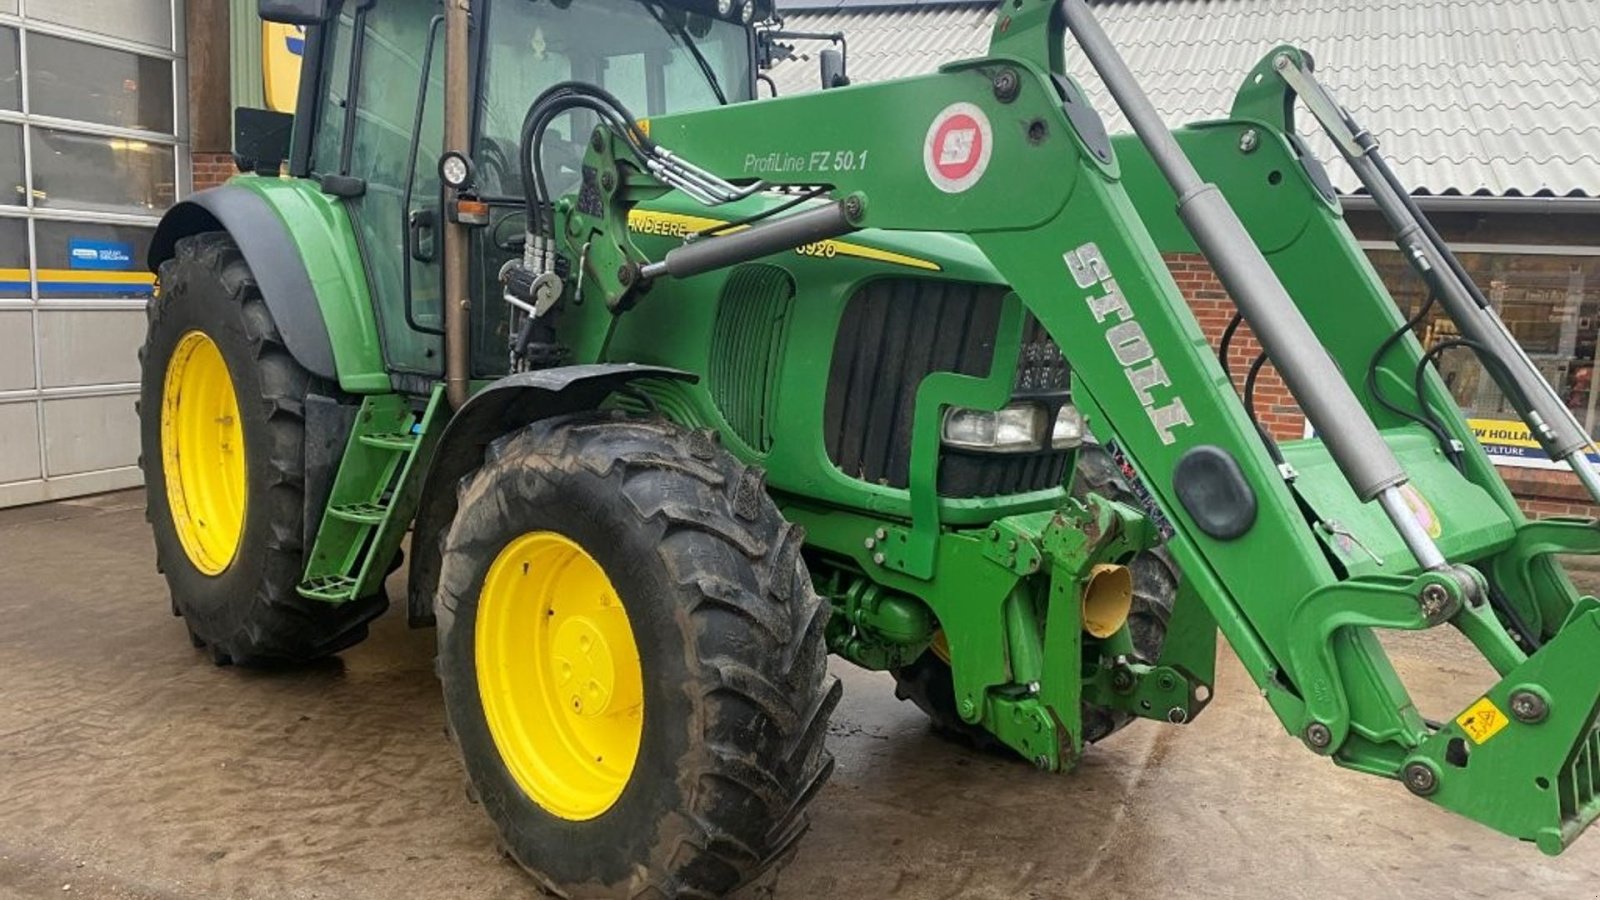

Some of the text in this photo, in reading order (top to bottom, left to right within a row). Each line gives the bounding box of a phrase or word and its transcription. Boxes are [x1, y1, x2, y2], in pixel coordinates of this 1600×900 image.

[743, 150, 868, 172] ProfiLine FZ 50.1
[1063, 242, 1194, 446] STOLL
[1482, 446, 1525, 456] ULTURE
